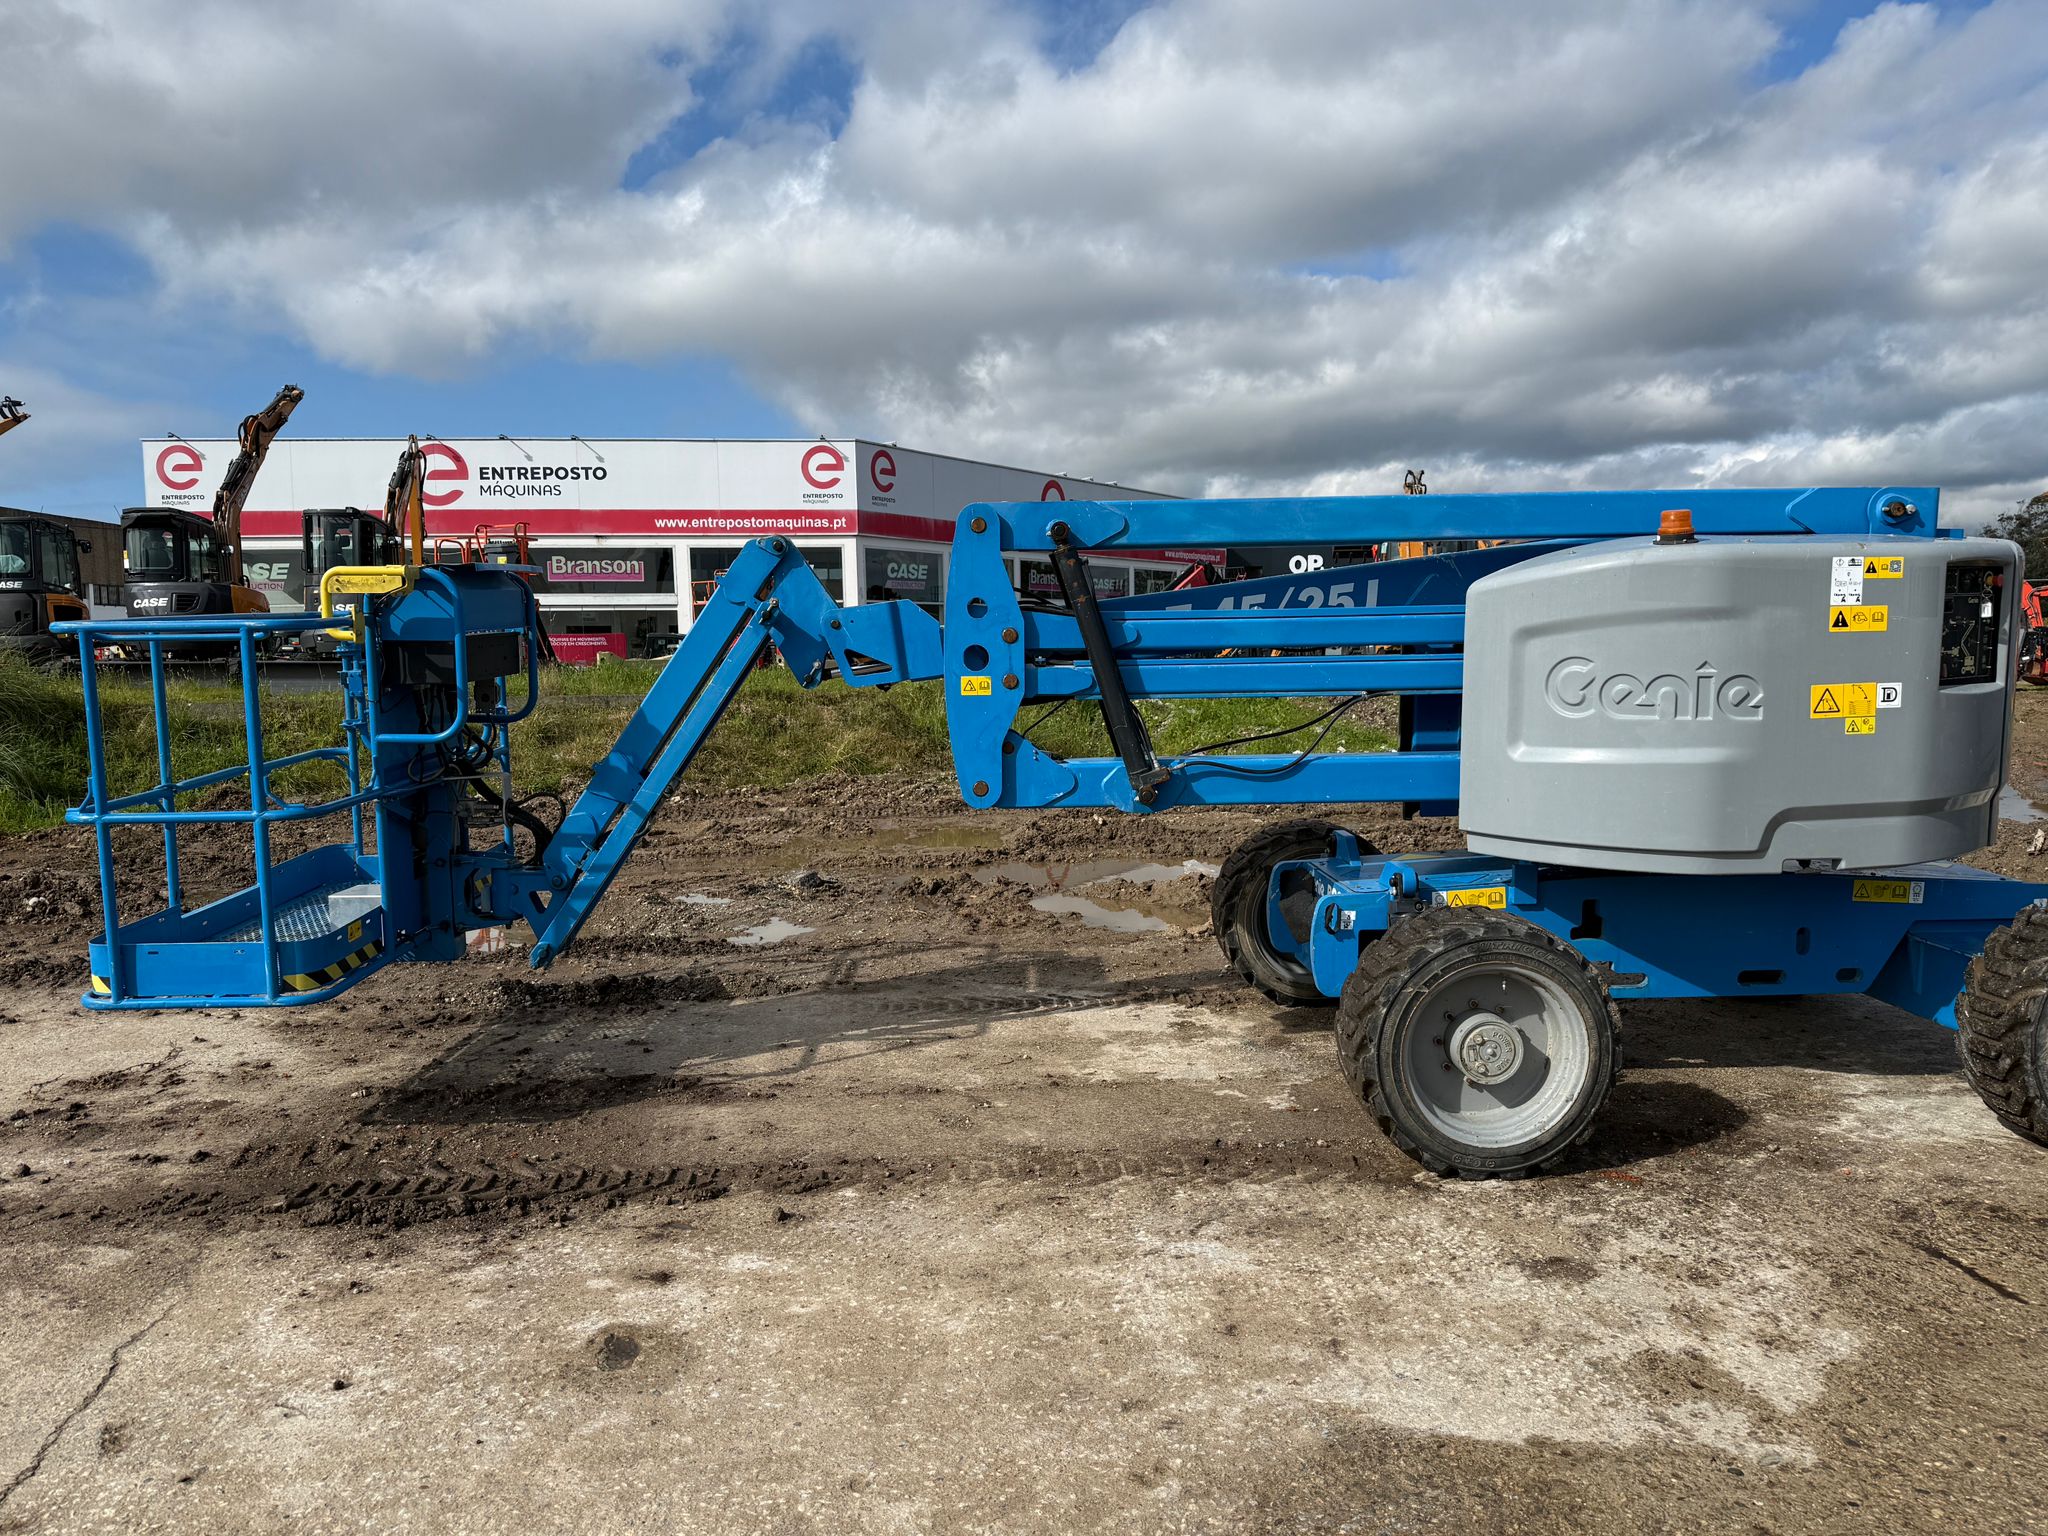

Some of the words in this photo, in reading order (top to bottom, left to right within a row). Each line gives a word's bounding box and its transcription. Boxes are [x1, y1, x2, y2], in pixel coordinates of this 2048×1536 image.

[479, 466, 608, 481] ENTREPOSTO
[479, 481, 562, 498] MÁQUINAS
[654, 516, 847, 530] www.entrepostomaquinas.pt
[551, 556, 640, 574] Branson
[887, 562, 929, 579] CASE
[133, 598, 168, 608] CASE
[1545, 656, 1764, 720] Genie
[1492, 1031, 1513, 1053] POWER
[1496, 1058, 1510, 1071] HUB
